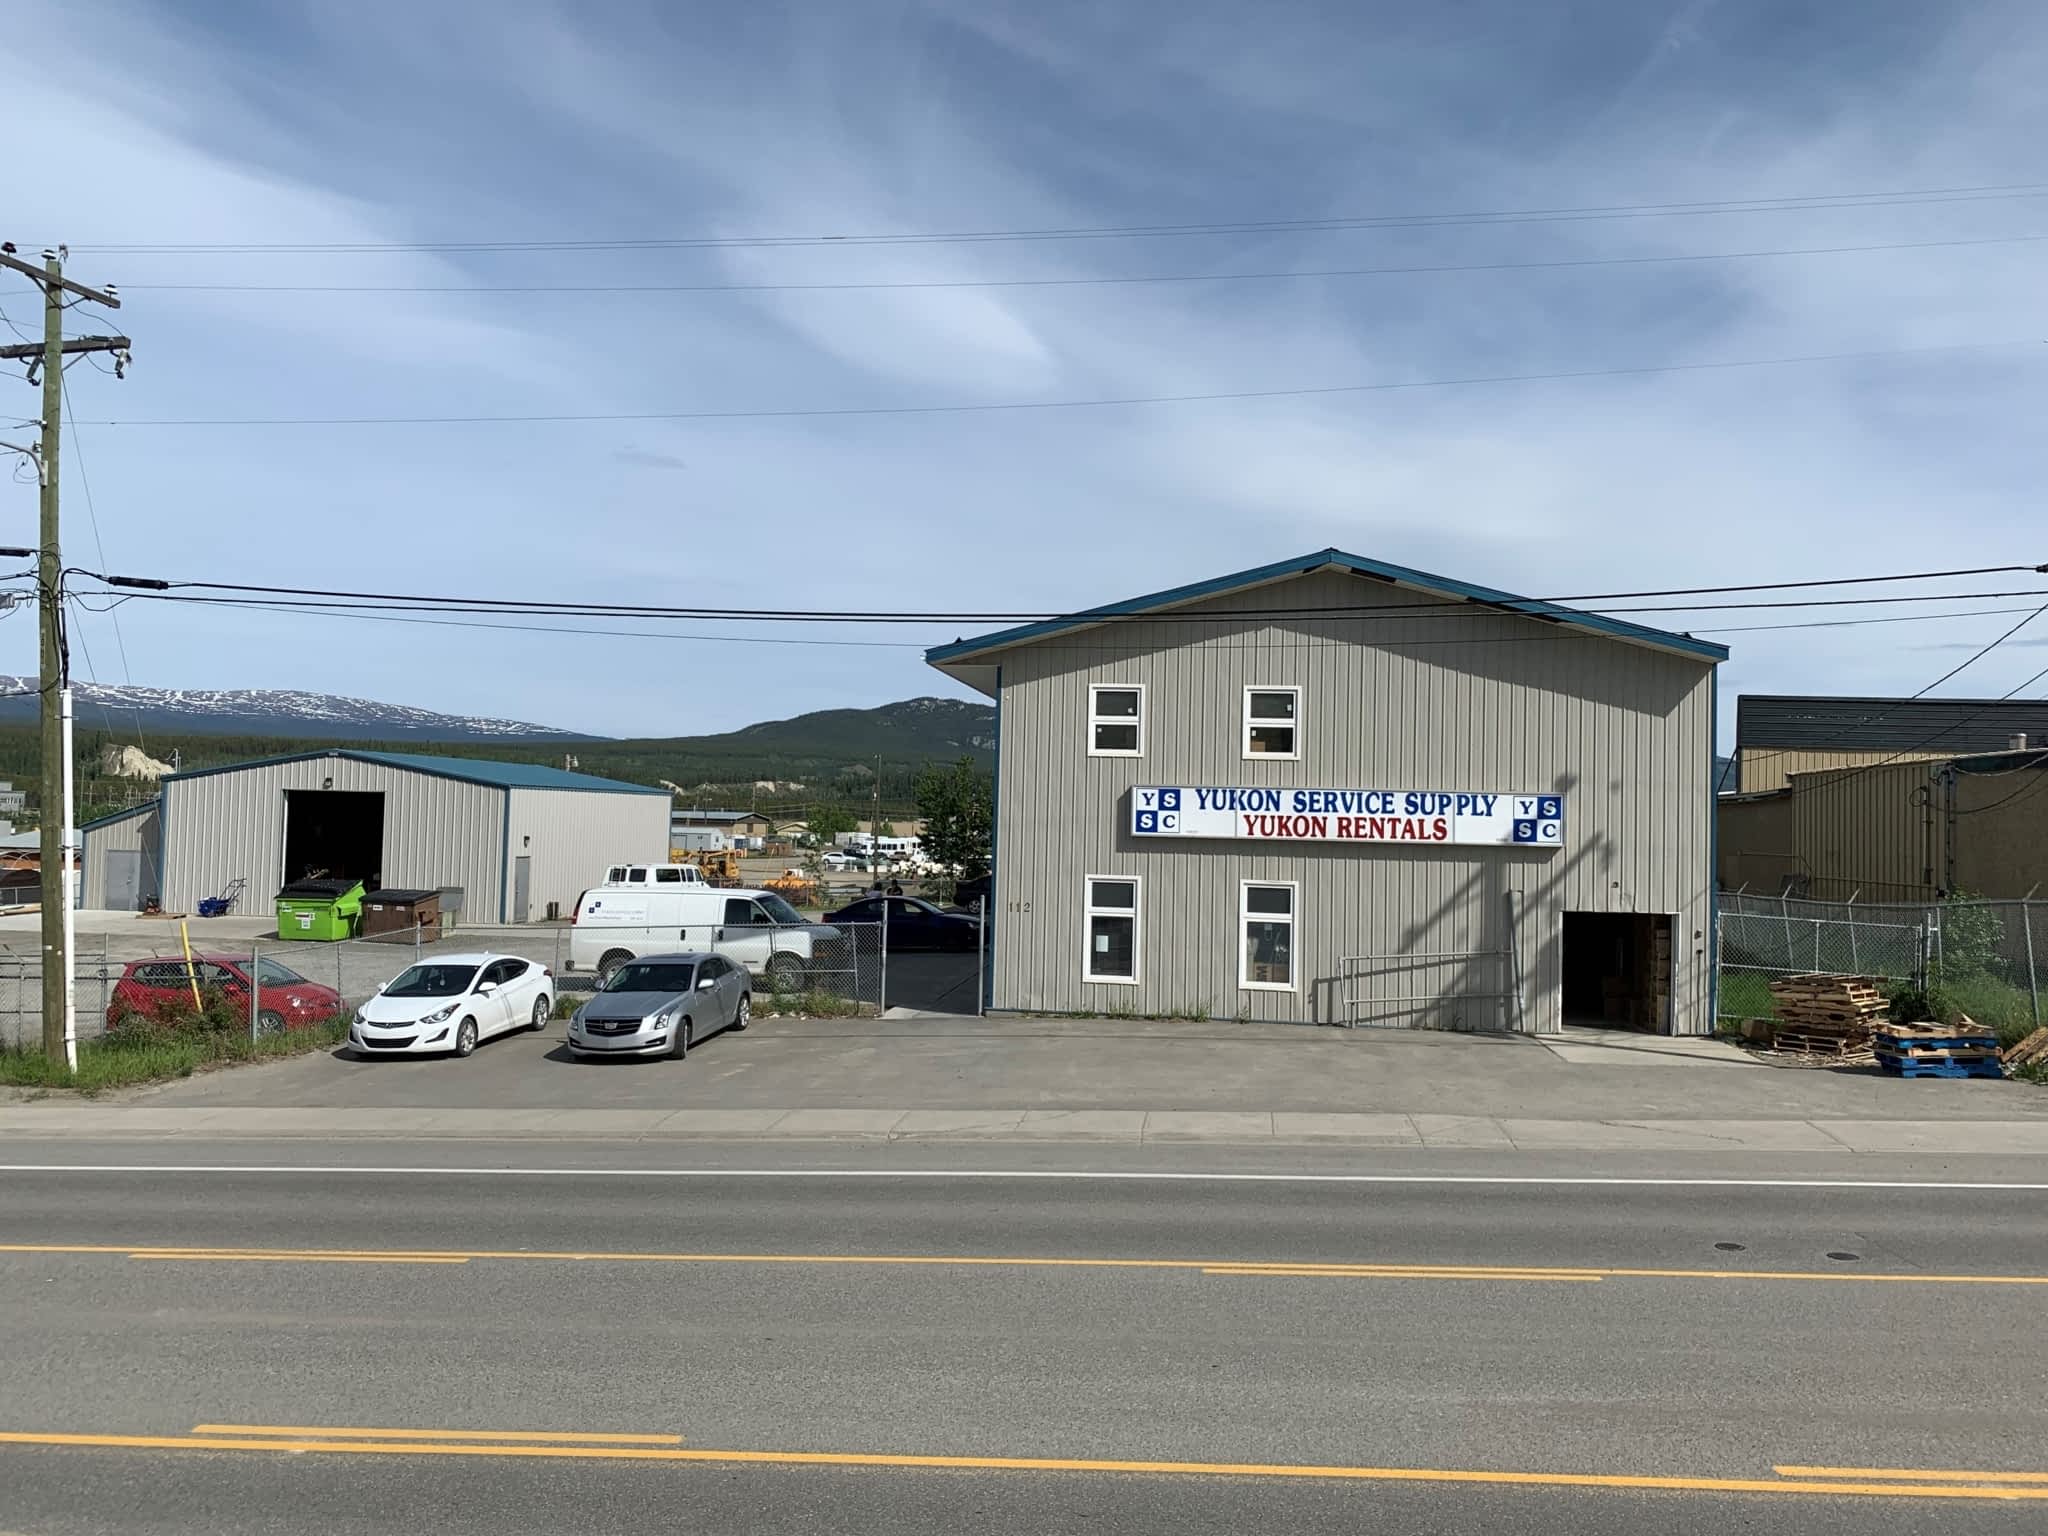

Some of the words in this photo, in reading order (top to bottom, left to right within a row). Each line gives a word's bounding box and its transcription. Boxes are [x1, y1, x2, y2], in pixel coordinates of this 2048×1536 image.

[1195, 788, 1281, 811] YUKON
[1293, 790, 1395, 814] SERVICE
[1404, 791, 1498, 817] SUPPLY
[1243, 814, 1328, 838] YUKON
[1337, 816, 1448, 841] RENTALS
